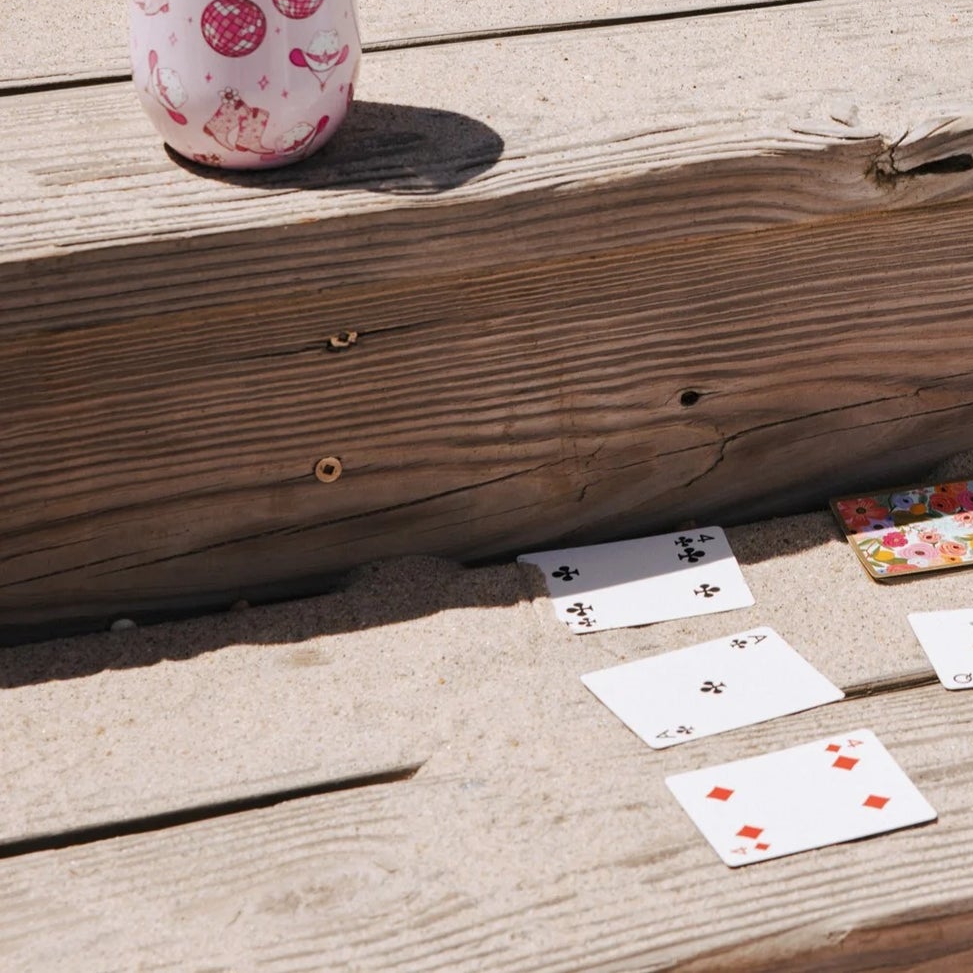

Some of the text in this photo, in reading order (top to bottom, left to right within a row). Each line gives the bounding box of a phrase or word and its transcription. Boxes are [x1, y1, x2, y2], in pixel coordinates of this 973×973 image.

[697, 534, 716, 544] 4
[747, 635, 768, 645] A
[953, 673, 973, 684] Q
[655, 729, 677, 739] A
[846, 739, 864, 748] 4
